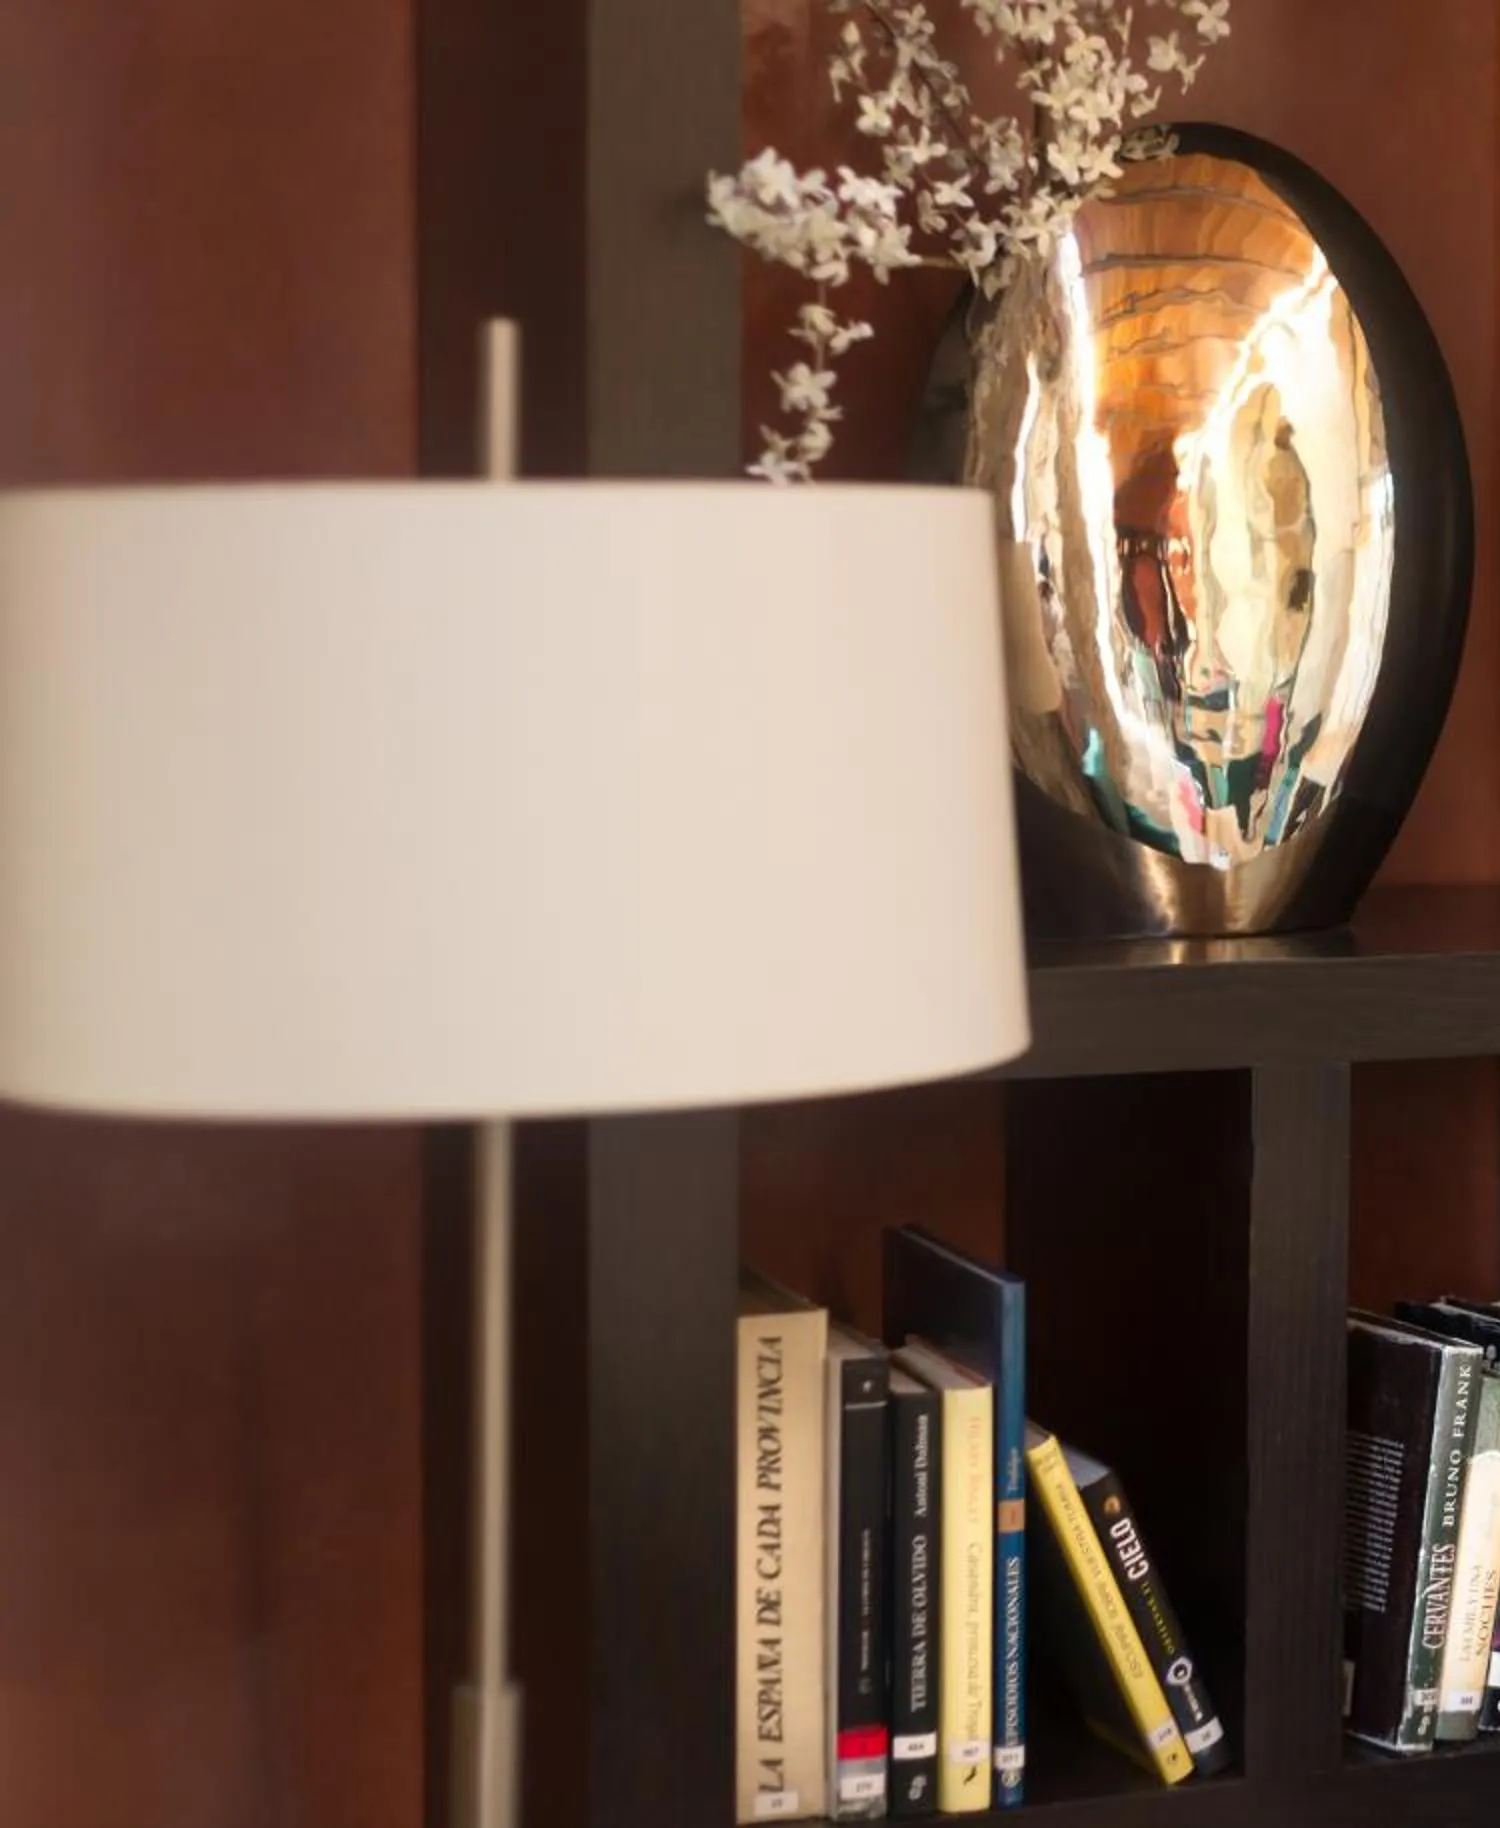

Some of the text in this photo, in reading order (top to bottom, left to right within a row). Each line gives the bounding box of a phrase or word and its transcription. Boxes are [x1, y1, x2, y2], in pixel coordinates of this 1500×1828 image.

[755, 1335, 783, 1492] PROVINCIA
[1442, 1364, 1472, 1526] BRUNO FRANK
[914, 1471, 928, 1517] Antoni
[755, 1503, 782, 1580] CADA
[1110, 1517, 1149, 1581] CIELO
[756, 1589, 782, 1626] DE
[911, 1535, 928, 1712] TIERRA DE OLVIDO
[1421, 1543, 1455, 1649] CERVANTES
[757, 1759, 783, 1791] LA
